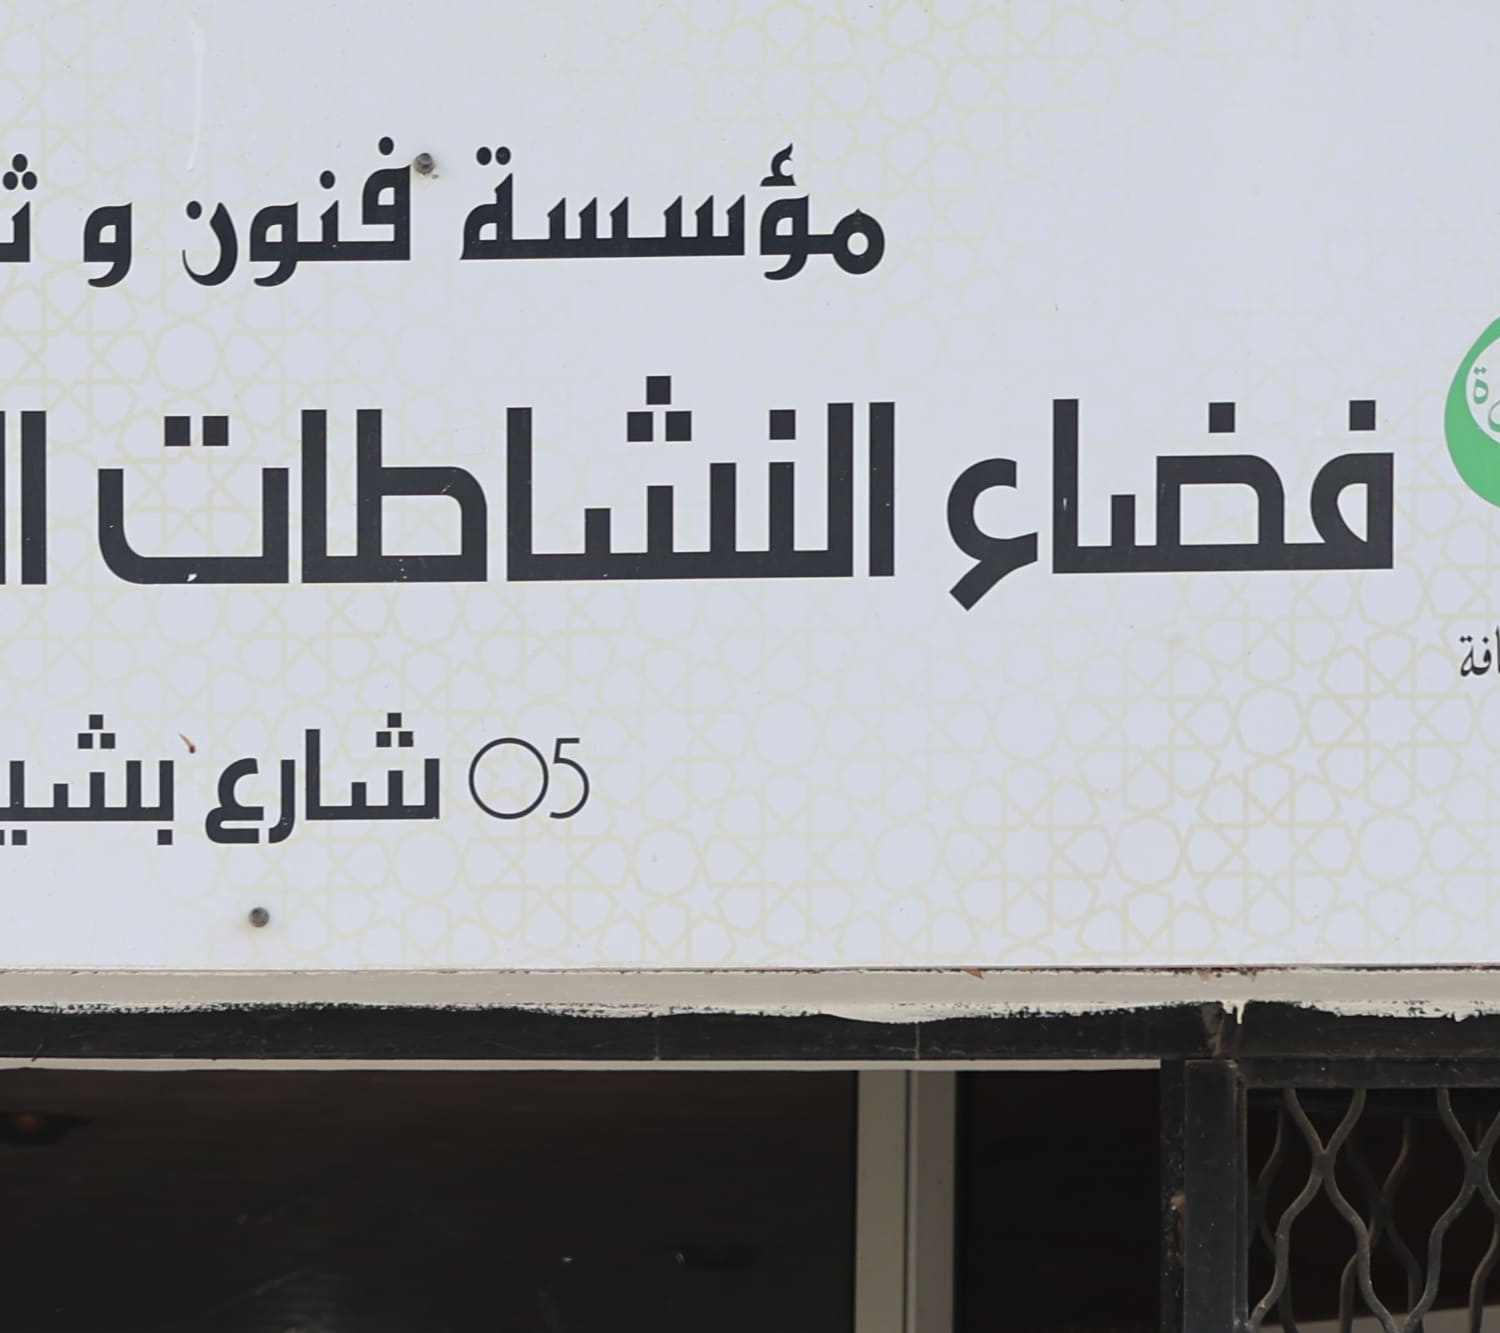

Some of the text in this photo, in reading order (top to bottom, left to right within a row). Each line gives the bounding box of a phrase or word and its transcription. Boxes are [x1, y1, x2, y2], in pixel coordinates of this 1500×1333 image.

[84, 203, 131, 287] و
[183, 137, 410, 286] فنون
[461, 144, 884, 280] مؤسسة
[98, 376, 894, 584] النشاطات
[948, 399, 1393, 610] فضاء
[206, 713, 439, 843] شارع
[469, 738, 589, 819] 05
